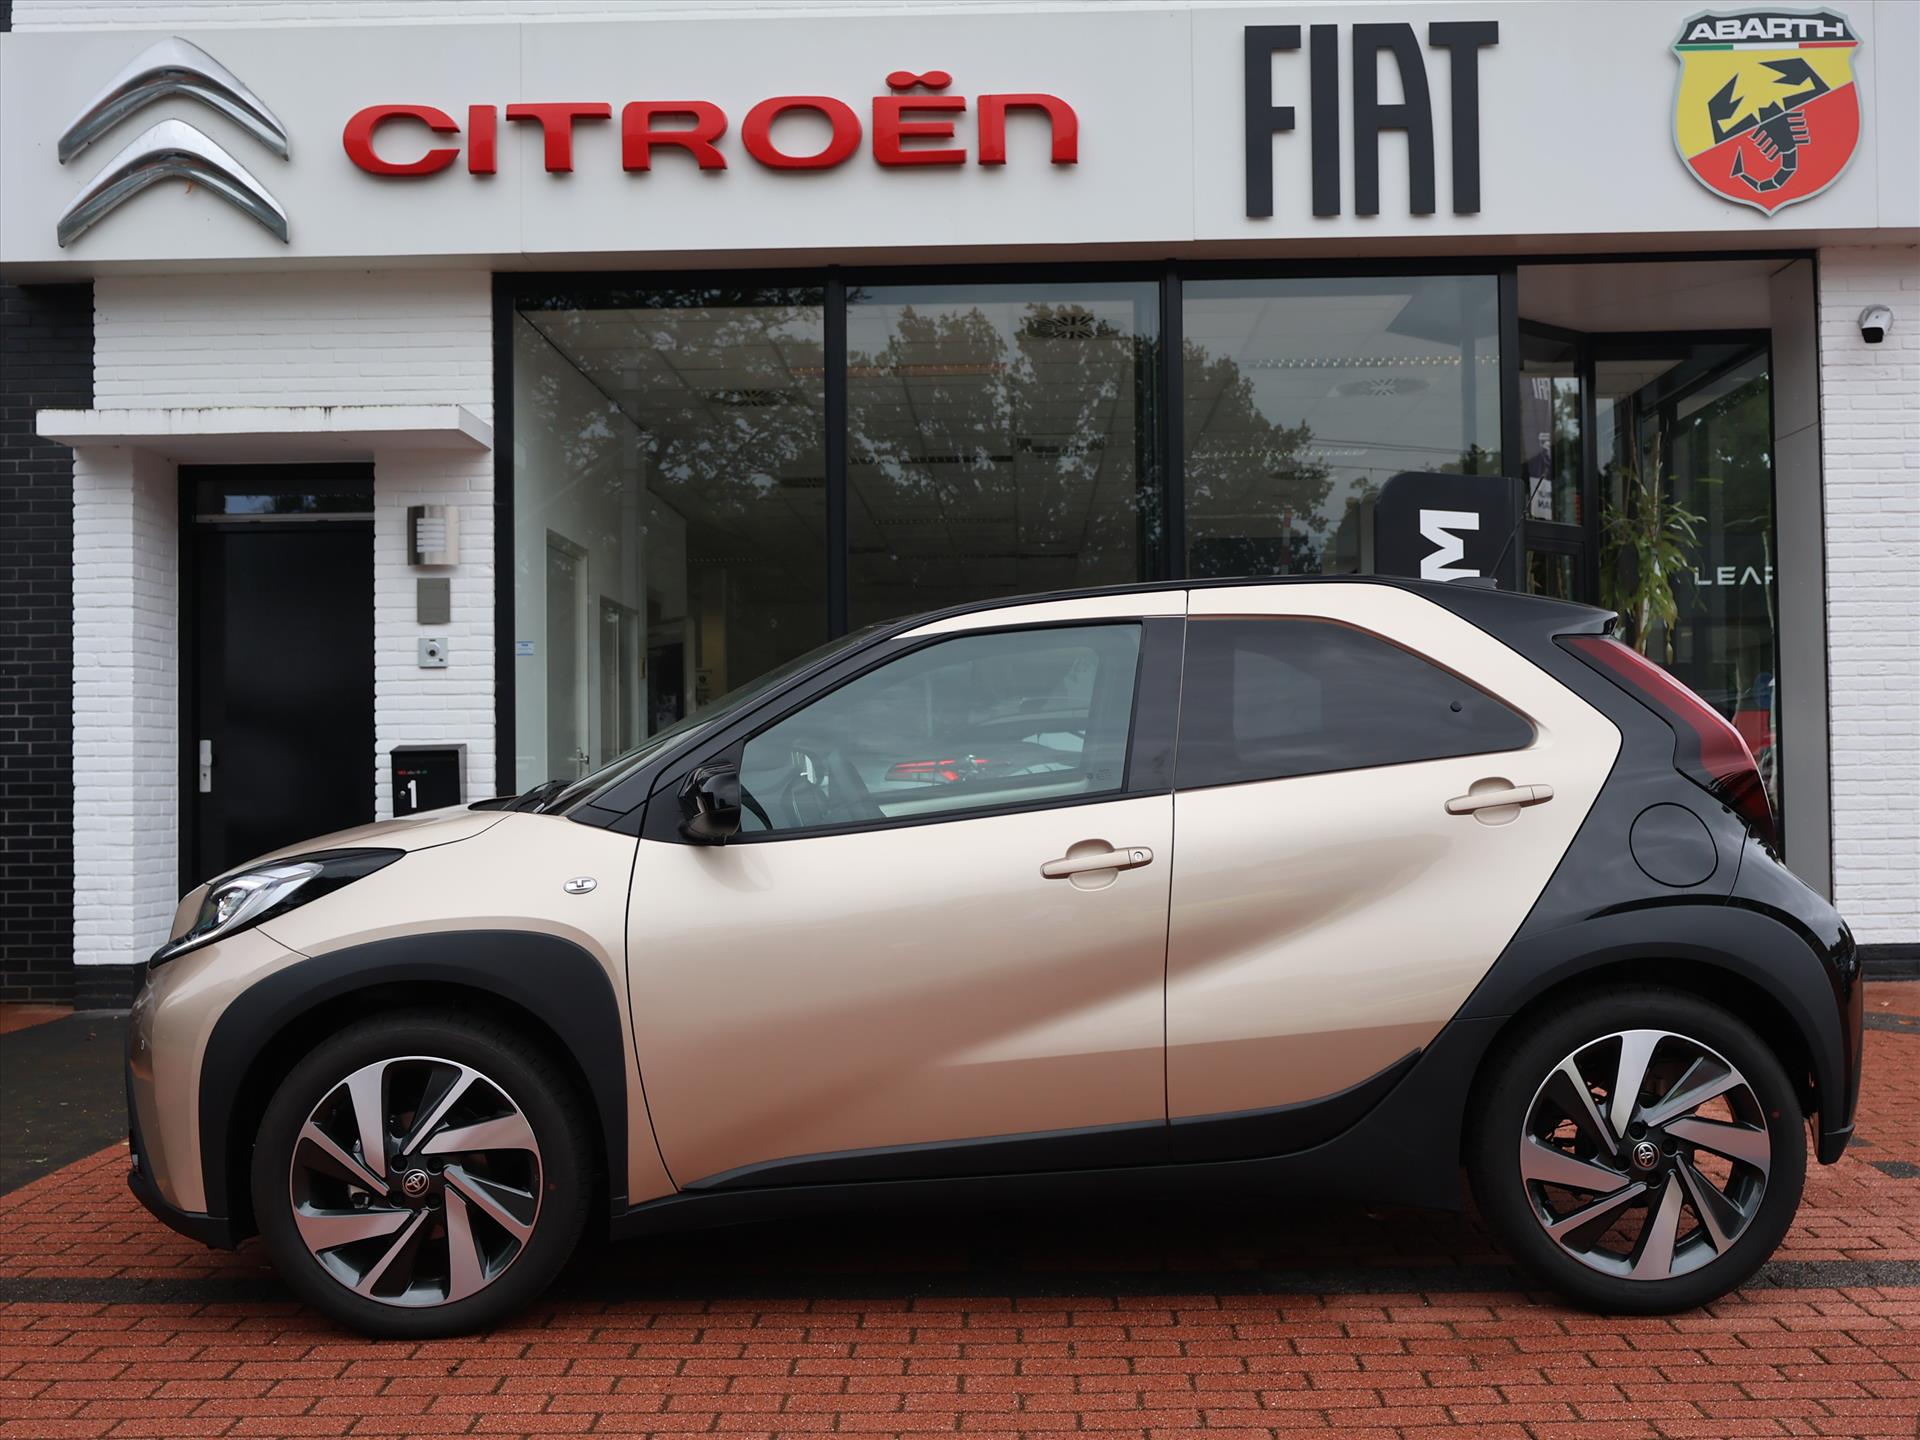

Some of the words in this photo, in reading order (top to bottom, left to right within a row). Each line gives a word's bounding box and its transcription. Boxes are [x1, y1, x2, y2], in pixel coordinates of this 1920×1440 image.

[1687, 17, 1844, 41] ABARTH
[1245, 21, 1499, 218] FIAT
[1419, 509, 1481, 581] M
[407, 780, 418, 809] 1
